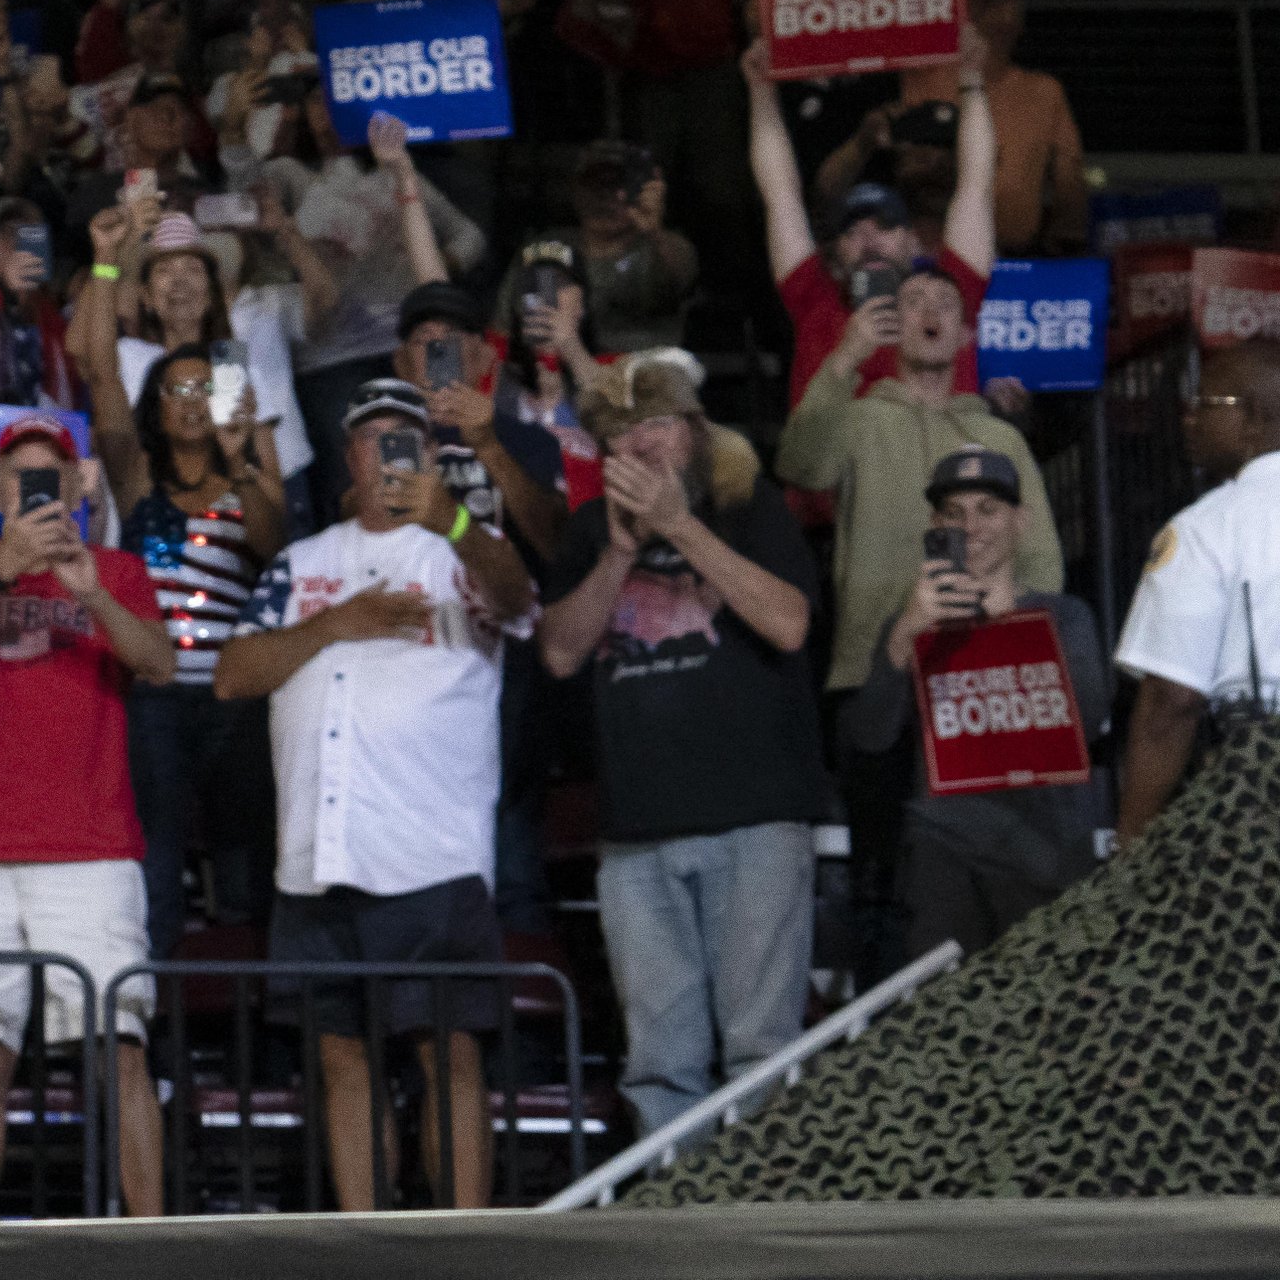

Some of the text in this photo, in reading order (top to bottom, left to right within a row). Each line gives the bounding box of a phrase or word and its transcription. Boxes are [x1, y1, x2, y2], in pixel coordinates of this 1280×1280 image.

[329, 34, 489, 71] SECURE OUR
[331, 57, 494, 104] BORDER
[1030, 298, 1092, 323] OUR
[927, 661, 1060, 701] SECURE OUR
[933, 687, 1075, 740] BORDER
